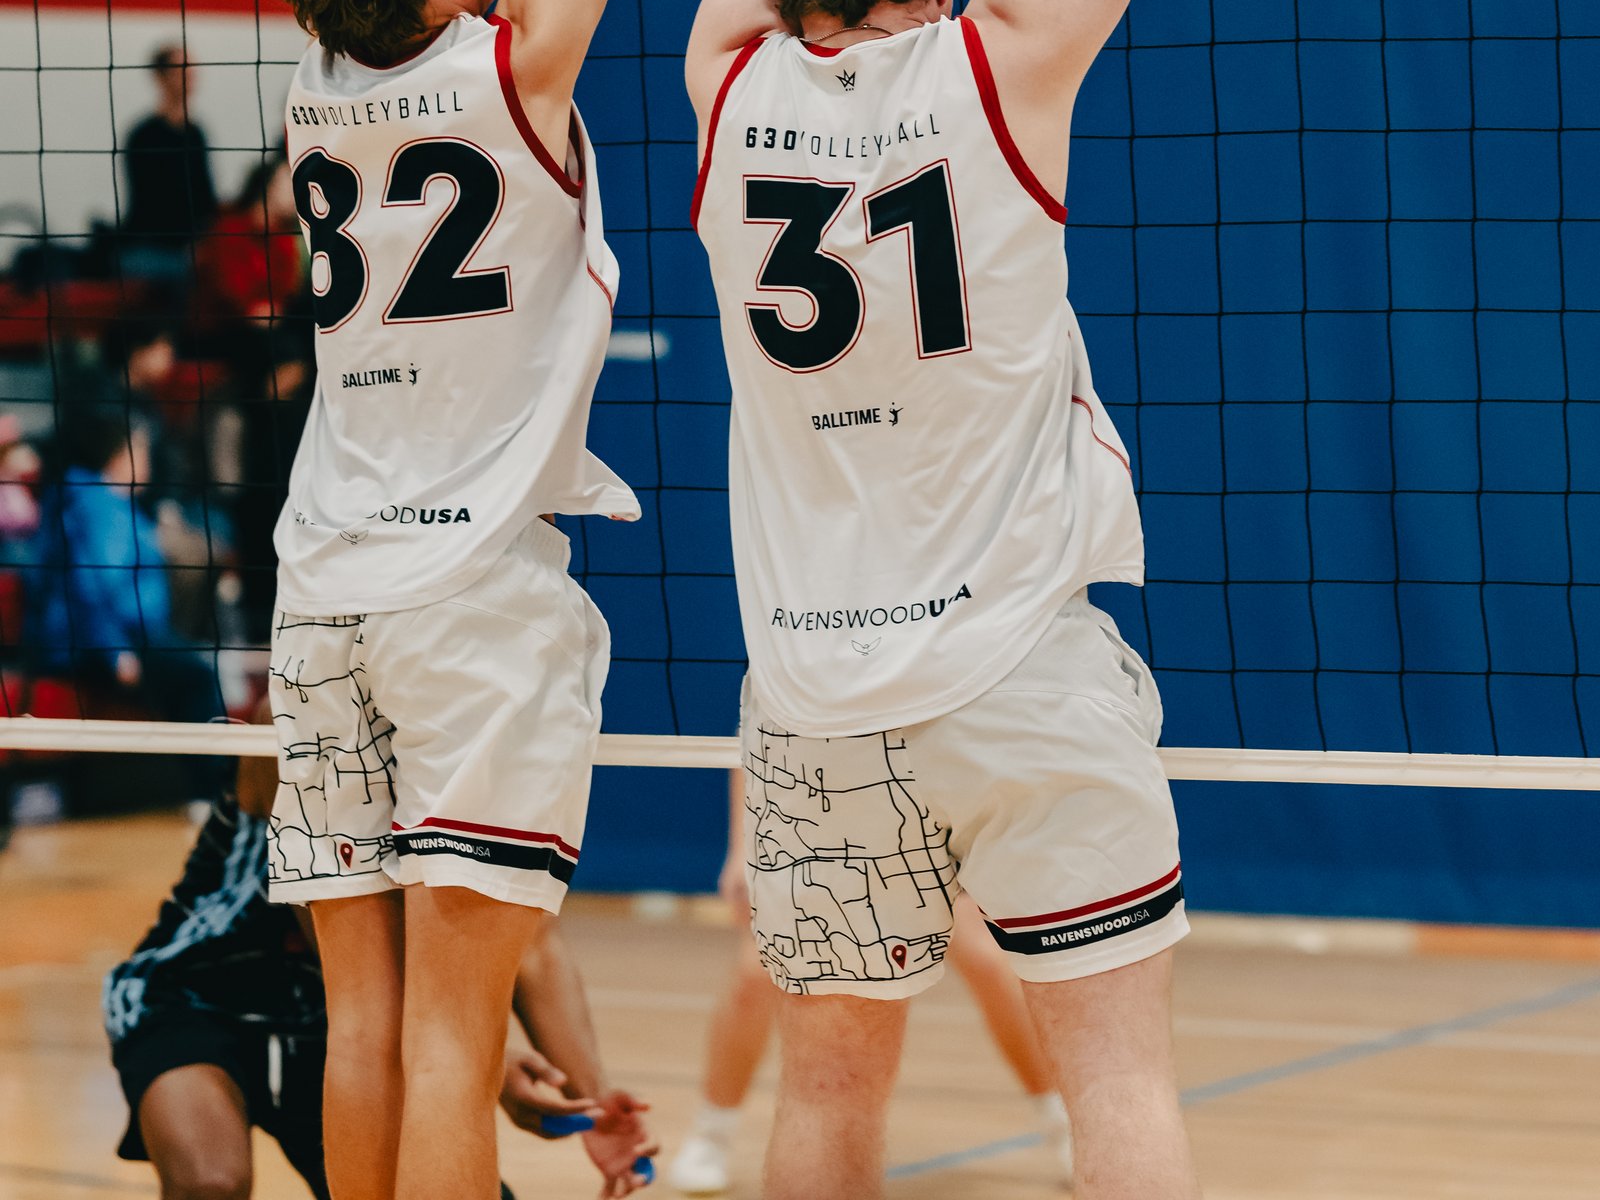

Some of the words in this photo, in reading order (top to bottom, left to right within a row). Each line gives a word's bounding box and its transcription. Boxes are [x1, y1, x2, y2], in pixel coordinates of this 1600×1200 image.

[292, 136, 513, 334] 82
[743, 158, 972, 374] 31
[342, 368, 403, 388] BALLTIME
[811, 407, 882, 430] BALLTIME
[771, 583, 972, 631] RVENSWOODUA
[1041, 909, 1150, 947] RAVENSWOODUSA
